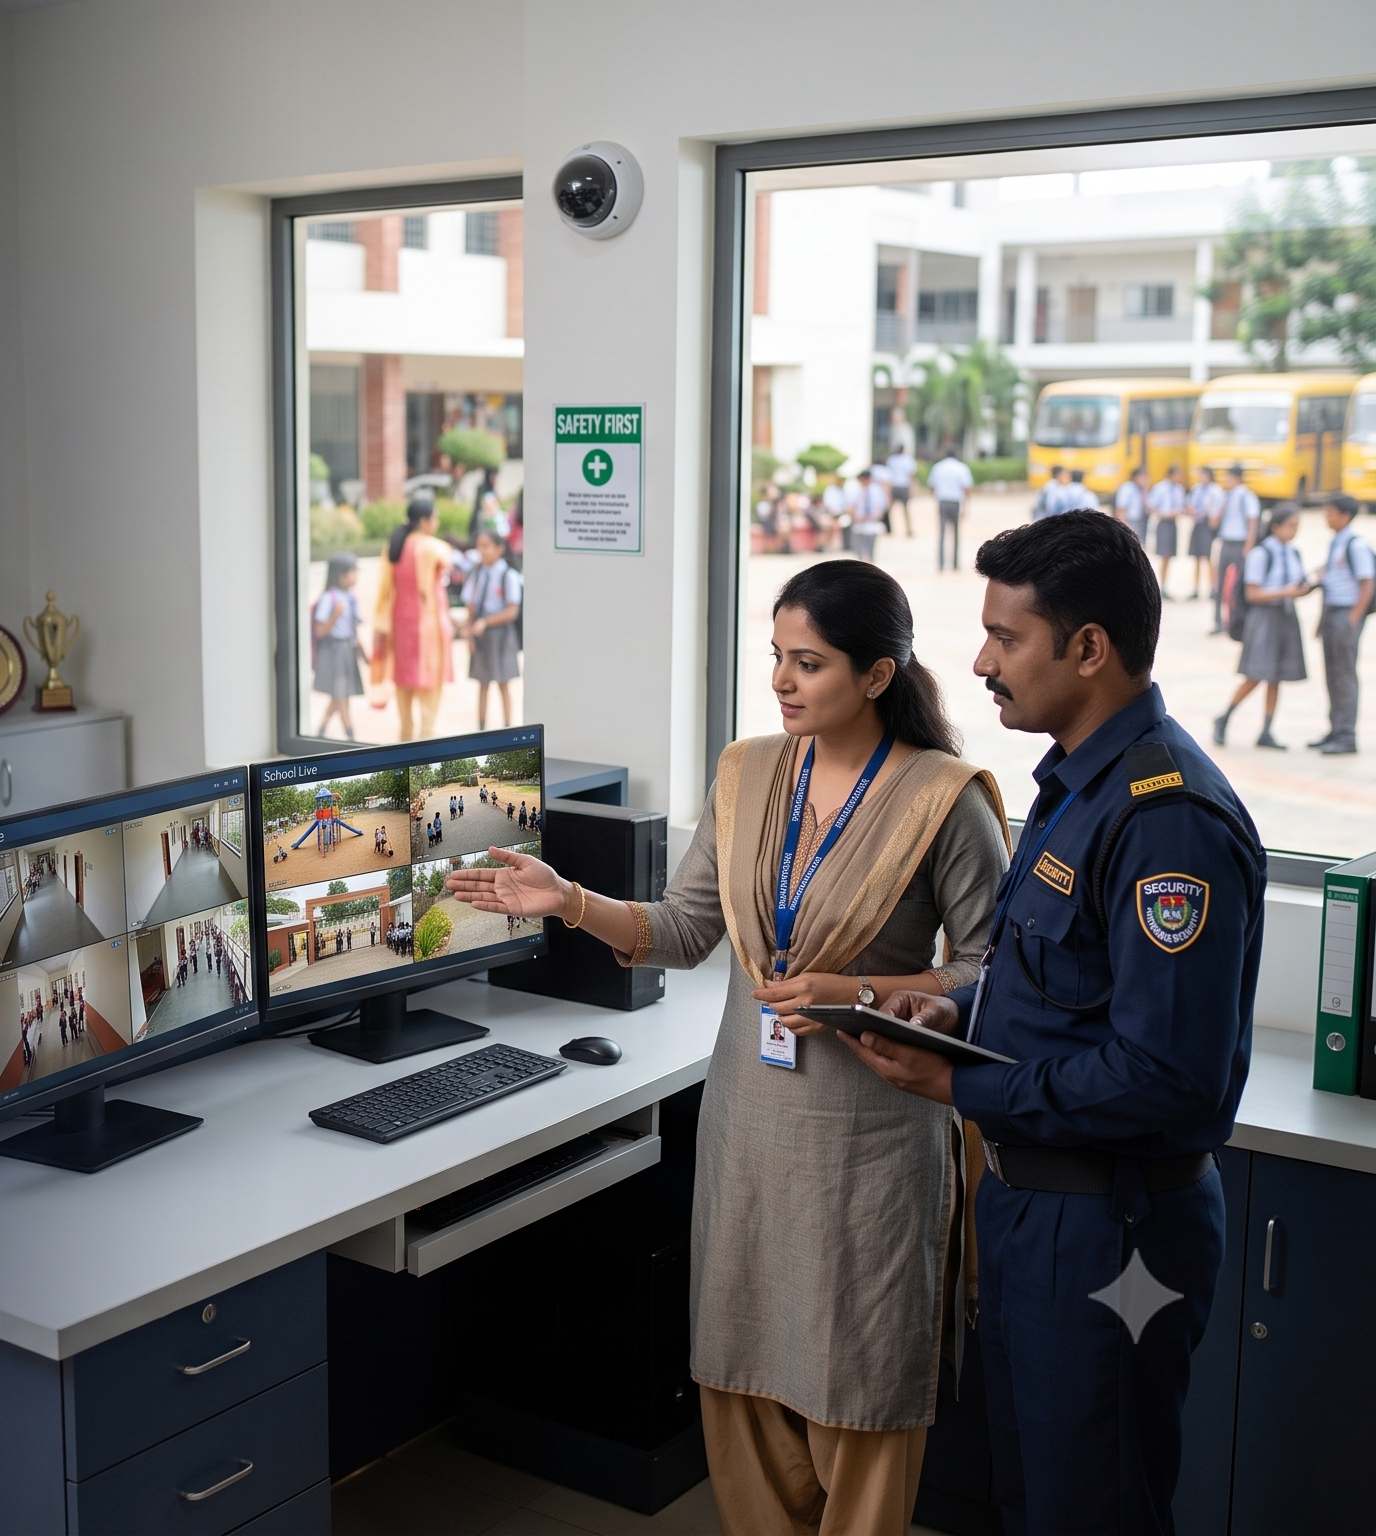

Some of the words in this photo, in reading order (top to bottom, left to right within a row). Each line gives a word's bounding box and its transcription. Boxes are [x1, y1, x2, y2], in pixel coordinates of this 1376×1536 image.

[557, 414, 602, 434] SAFETY
[605, 414, 639, 434] FIRST
[264, 766, 296, 782] School
[298, 765, 318, 777] Live
[1144, 882, 1203, 896] SECURITY
